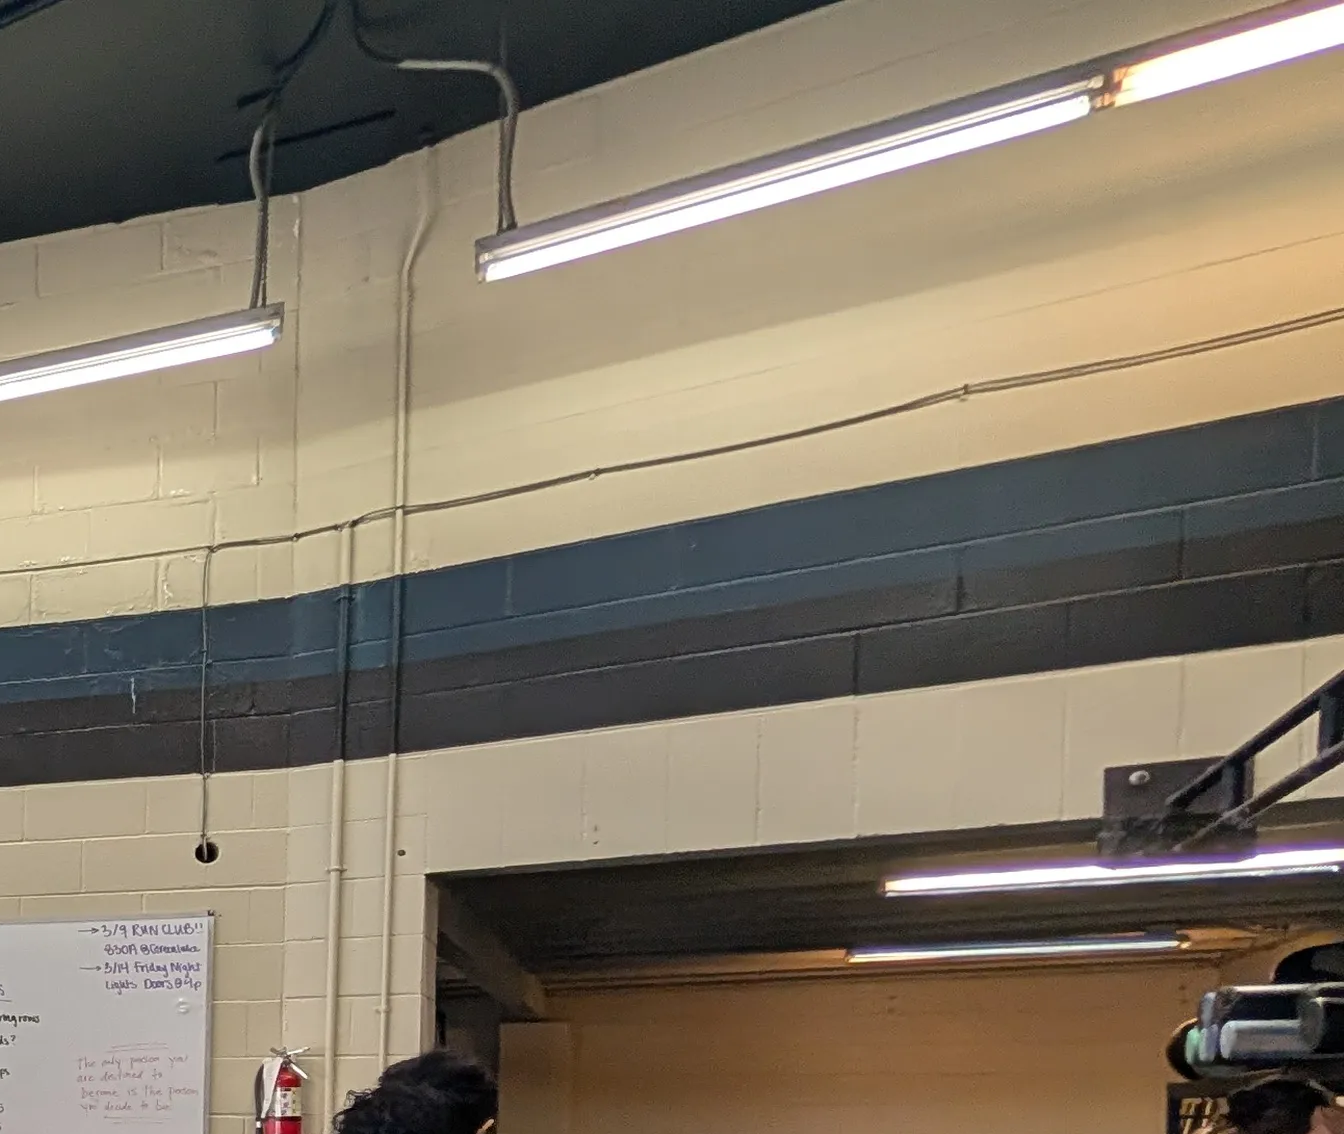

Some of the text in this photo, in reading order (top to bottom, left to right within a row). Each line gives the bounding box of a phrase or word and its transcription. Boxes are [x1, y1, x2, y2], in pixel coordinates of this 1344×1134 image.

[100, 923, 128, 939] 3/9
[132, 923, 159, 937] RUN
[104, 961, 202, 979] 3/14 Friday Night
